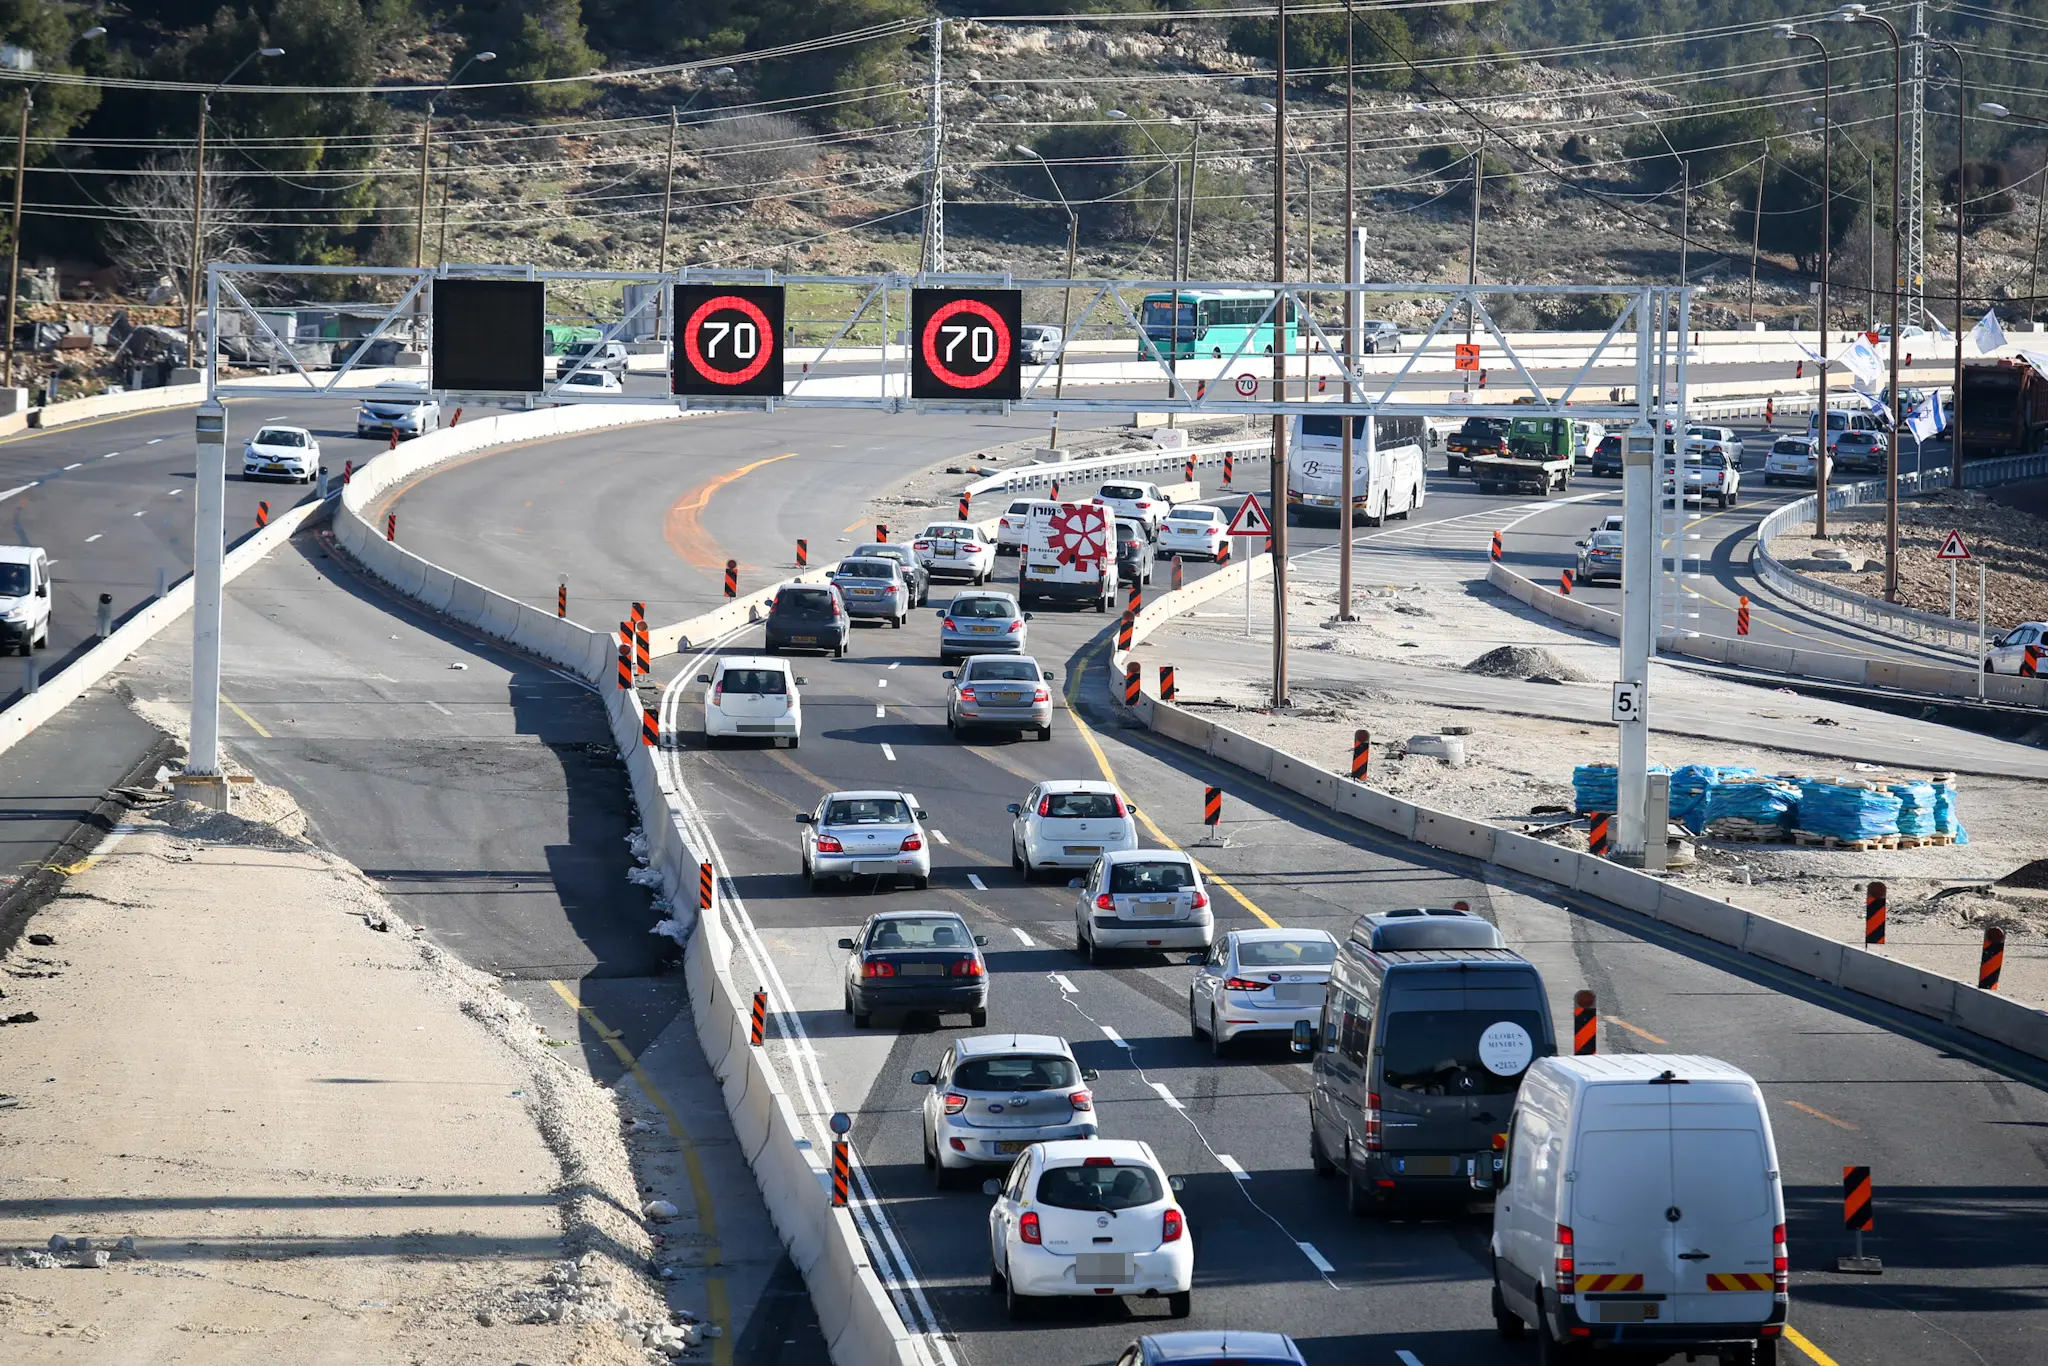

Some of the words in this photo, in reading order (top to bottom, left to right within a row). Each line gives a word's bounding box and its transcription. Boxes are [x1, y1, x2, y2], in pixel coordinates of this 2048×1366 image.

[703, 321, 756, 359] 70
[941, 325, 994, 363] 70
[1240, 380, 1254, 390] 70
[1033, 506, 1056, 517] מורן
